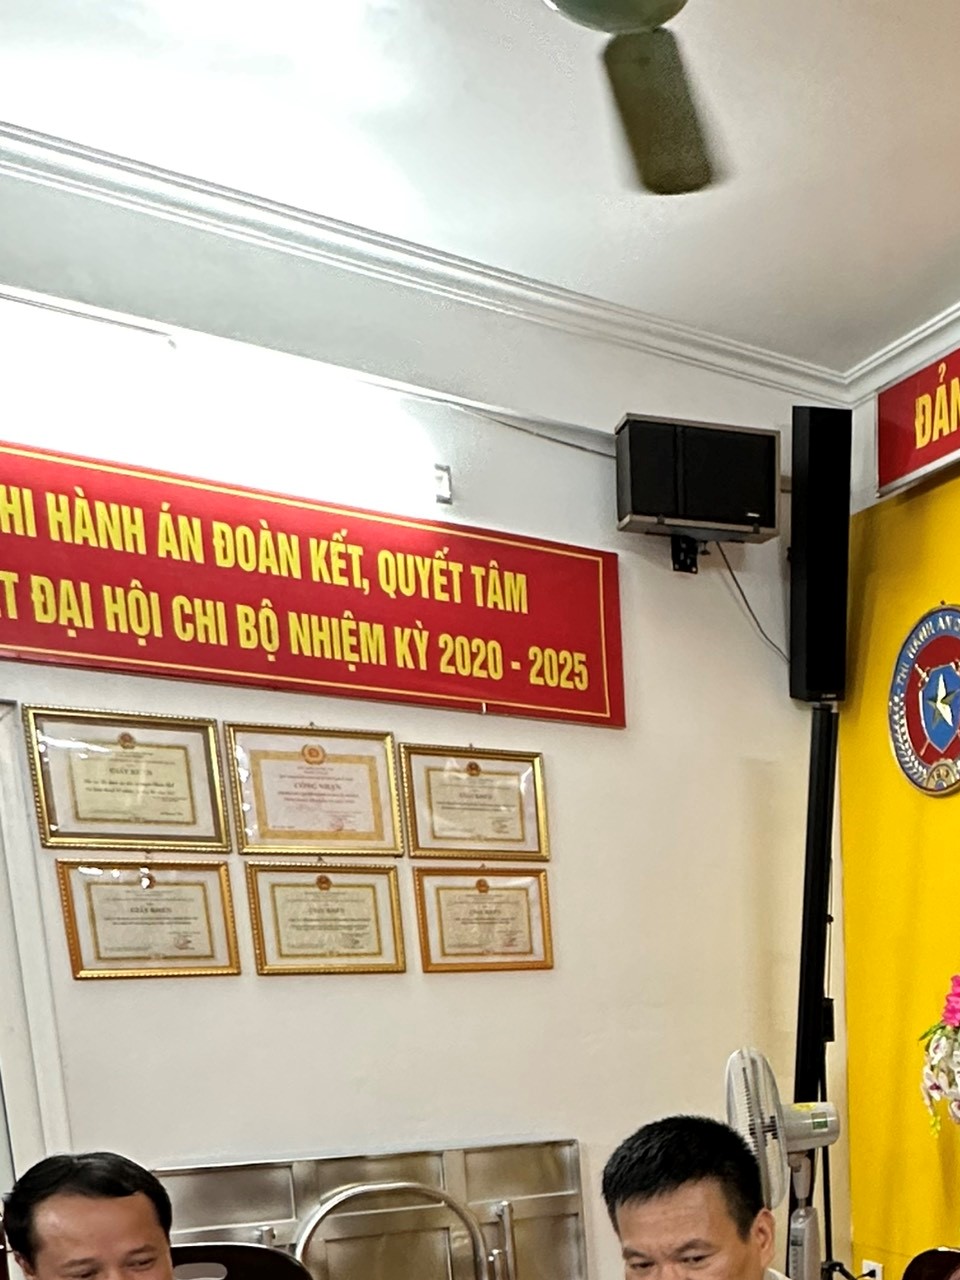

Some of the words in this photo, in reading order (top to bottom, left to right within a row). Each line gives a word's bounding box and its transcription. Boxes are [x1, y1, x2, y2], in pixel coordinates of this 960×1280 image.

[46, 486, 145, 556] HÀNH
[157, 502, 205, 564] ÁN
[212, 519, 302, 580] ĐOÀN
[308, 530, 371, 595] KẾT,
[377, 547, 465, 603] QUYẾT
[471, 561, 529, 615] TÂM
[31, 575, 94, 638] ĐẠI
[104, 580, 162, 647] HỘI
[171, 595, 229, 646] CHI
[237, 599, 280, 662] BỘ
[289, 607, 387, 672] NHIỆM
[394, 620, 431, 671] KỲ
[438, 633, 504, 680] 2020
[528, 646, 590, 691] 2025
[906, 623, 935, 660] HÀNH
